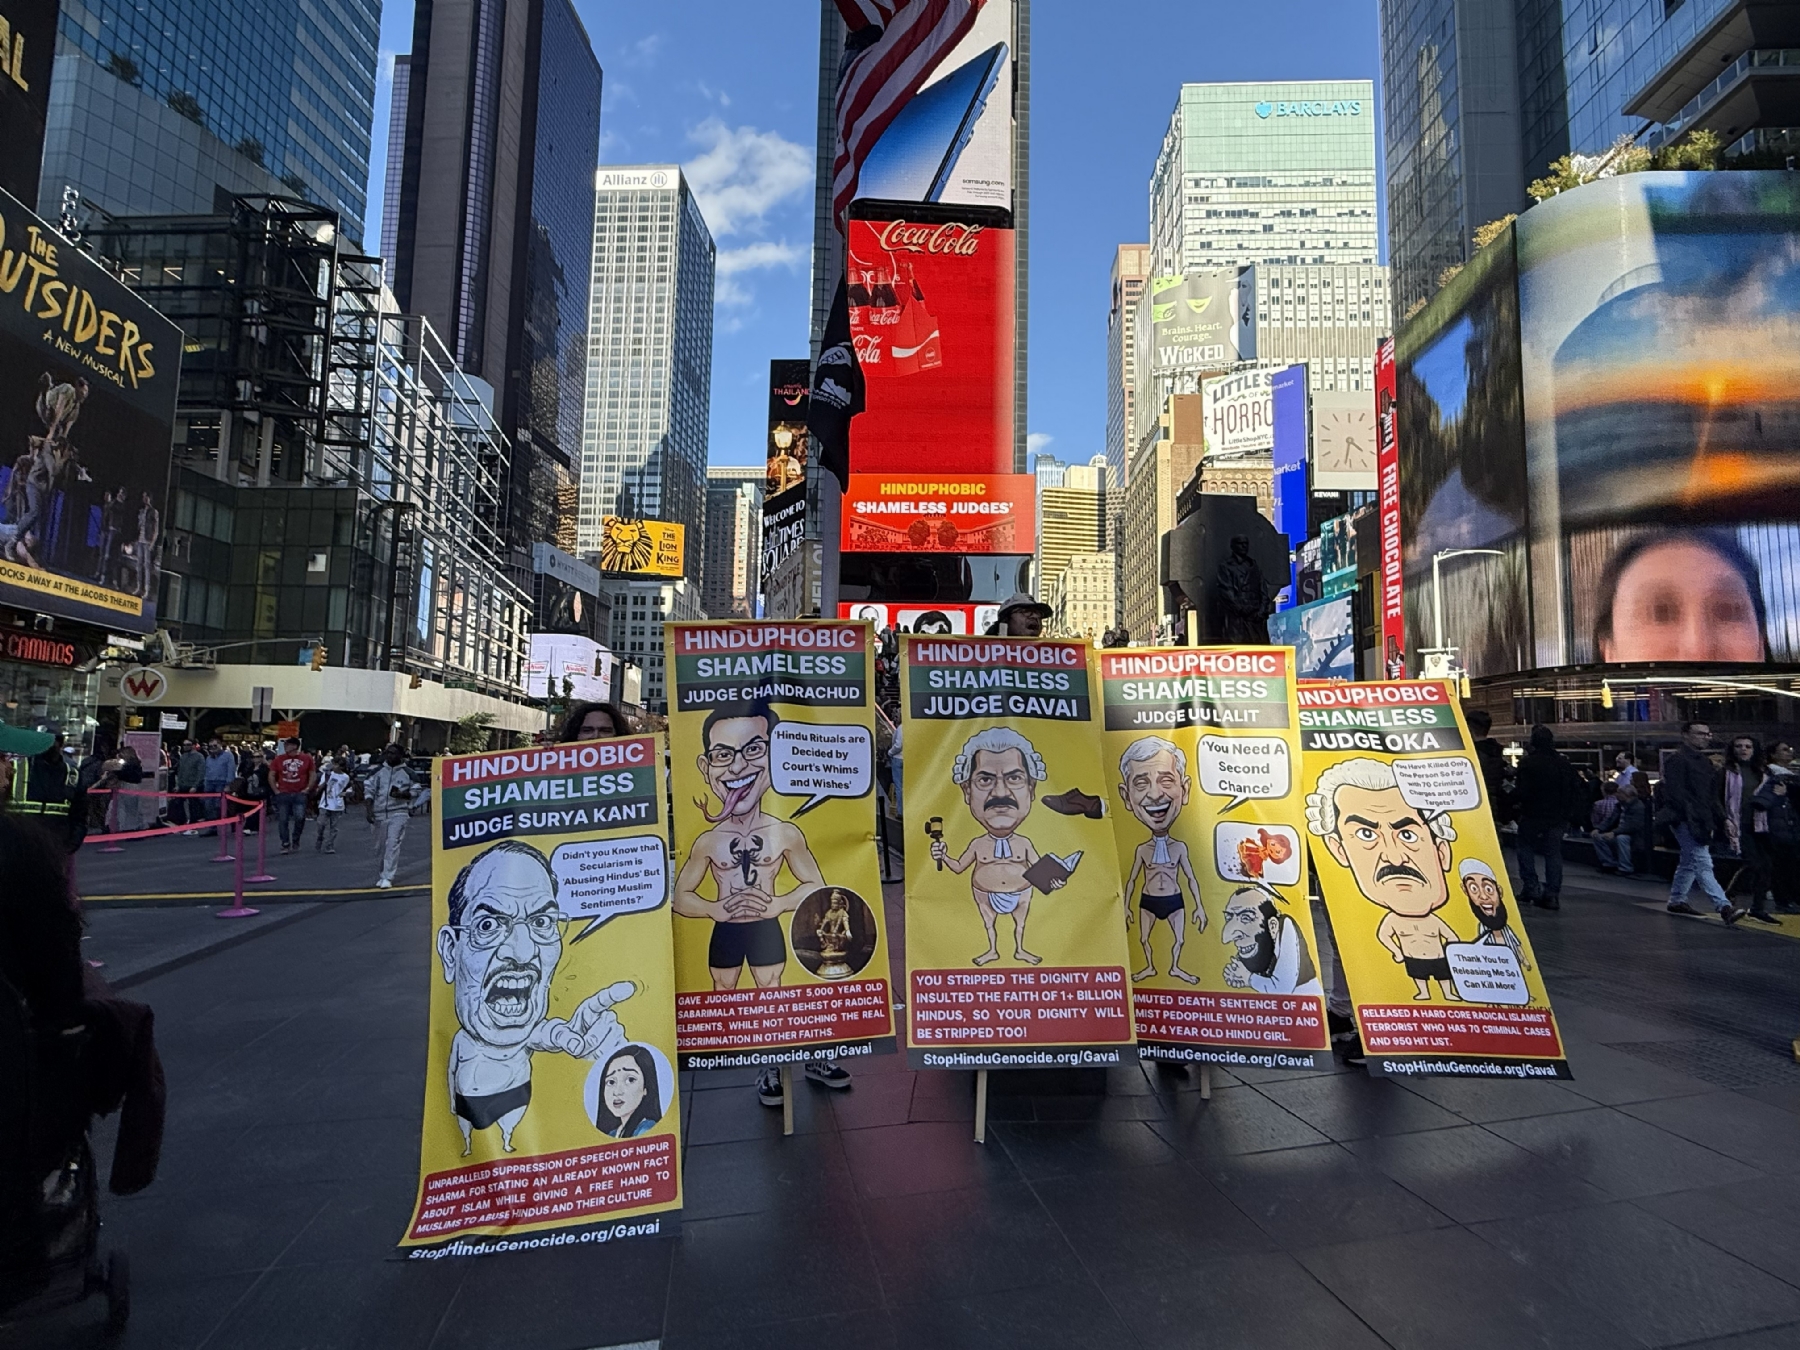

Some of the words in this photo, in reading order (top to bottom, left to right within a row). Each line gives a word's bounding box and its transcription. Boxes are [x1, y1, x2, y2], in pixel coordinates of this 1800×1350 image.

[1276, 101, 1361, 117] BARCLAYS
[602, 174, 647, 185] Allianz
[962, 178, 1005, 187] samsung.com
[27, 225, 59, 267] THE
[879, 219, 985, 255] Coca-Cola
[0, 211, 155, 390] UTSIDERS
[1162, 326, 1193, 336] Brains.
[1194, 322, 1222, 332] Heart.
[1172, 333, 1212, 343] Courage.
[42, 329, 54, 343] A
[55, 336, 82, 358] NEW
[83, 355, 125, 389] MUSICAL
[1213, 373, 1260, 405] LITTLE
[1213, 399, 1273, 446] HORRO
[880, 483, 986, 495] HINDUPHOBIC
[1383, 462, 1398, 509] FREE
[763, 504, 796, 527] WELCOME
[796, 499, 806, 512] TO
[662, 532, 675, 540] THE
[779, 518, 805, 544] TIMES
[659, 541, 677, 551] LION
[656, 552, 679, 565] KING
[1383, 512, 1401, 620] CHOCOLATE
[27, 574, 52, 588] AWAY
[53, 581, 62, 590] AT
[64, 584, 79, 595] THE
[80, 588, 108, 602] JACOBS
[110, 595, 139, 611] THEATRE
[1302, 578, 1322, 604] Si
[684, 627, 856, 650] HINDUPHOBIC
[917, 643, 1077, 665] HINDUPHOBIC
[697, 653, 846, 677] SHAMELESS
[1110, 655, 1276, 675] HINDUPHOBIC
[125, 675, 160, 698] W
[929, 669, 1070, 690] SHAMELESS
[684, 688, 738, 704] JUDGE
[741, 683, 860, 700] CHANDRACHUD
[1122, 680, 1268, 700] SHAMELESS
[924, 695, 1002, 715] JUDGE
[1009, 695, 1078, 717] GAVAI
[1133, 709, 1186, 724] JUDGE
[1188, 708, 1211, 721] UU
[1213, 709, 1260, 722] LALIT
[1299, 708, 1437, 727] SHAMELESS
[774, 730, 808, 741] 'Hindu
[810, 733, 845, 744] Rituals
[848, 735, 866, 744] are
[1309, 732, 1383, 750] JUDGE
[1385, 732, 1440, 751] OKA
[791, 746, 833, 759] Decided
[835, 750, 849, 761] by
[1202, 741, 1229, 754] 'You
[1232, 743, 1270, 755] Need
[1273, 744, 1285, 755] A
[453, 743, 645, 782] HINDUPHOBIC
[782, 762, 821, 773] Court's
[823, 764, 859, 774] Whims
[1218, 761, 1270, 774] Second
[464, 772, 634, 810] SHAMELESS
[790, 777, 810, 787] and
[812, 779, 852, 790] Wishes'
[1218, 779, 1273, 794] Chance'
[449, 814, 514, 841] JUDGE
[517, 810, 589, 829] SURYA
[593, 802, 650, 824] KANT
[562, 850, 590, 860] Didn't
[592, 849, 610, 859] you
[612, 847, 638, 856] Know
[640, 843, 660, 852] that
[580, 860, 633, 871] Secularism
[634, 857, 643, 866] is
[562, 874, 605, 886] 'Abusing
[606, 870, 642, 881] Hindus'
[644, 868, 660, 877] But
[570, 886, 616, 898] Honoring
[617, 882, 653, 893] Muslim
[916, 975, 942, 986] YOU
[947, 974, 1005, 985] STRIPPED
[1010, 974, 1035, 984] THE
[1040, 972, 1089, 984] DIGNITY
[1095, 972, 1121, 983] AND
[678, 996, 701, 1006] GAVE
[704, 993, 755, 1004] JUDGMENT
[759, 989, 802, 1000] AGAINST
[806, 986, 833, 998] 5,000
[838, 984, 861, 994] YEAR
[865, 983, 883, 992] OLD
[916, 992, 974, 1004] INSULTED
[977, 992, 1001, 1002] THE
[1003, 991, 1039, 1002] FAITH
[1041, 991, 1058, 1001] OF
[1060, 990, 1074, 1001] 1+
[1076, 989, 1123, 1000] BILLION
[677, 1006, 735, 1019] SABARIMALA
[738, 1003, 775, 1016] TEMPLE
[777, 1003, 790, 1013] AT
[792, 999, 828, 1012] BEHEST
[831, 999, 843, 1008] OF
[845, 995, 884, 1007] RADICAL
[916, 1010, 966, 1022] HINDUS,
[972, 1009, 990, 1020] SO
[997, 1009, 1031, 1020] YOUR
[1038, 1008, 1088, 1019] DIGNITY
[1095, 1007, 1124, 1018] WILL
[917, 1028, 932, 1039] BE
[935, 1027, 994, 1039] STRIPPED
[996, 1026, 1027, 1038] TOO!
[1370, 1036, 1391, 1046] AND
[1392, 1037, 1413, 1046] 950
[1414, 1037, 1428, 1046] HIT
[1430, 1037, 1453, 1046] LIST.
[688, 1042, 872, 1069] StopHinduGenocide.org/Gavai
[923, 1050, 1119, 1067] StopHinduGenocide.org/Gavai
[1137, 1046, 1314, 1067] pHinduGenocide.org/Gavai
[1383, 1060, 1557, 1077] StopHinduGenocide.org/Gavai
[421, 1205, 455, 1220] ABOUT
[461, 1199, 491, 1212] ISLAM
[496, 1193, 526, 1207] WHILE
[532, 1188, 568, 1201] GIVING
[574, 1186, 583, 1195] A
[589, 1180, 614, 1192] FREE
[620, 1174, 649, 1188] HAND
[656, 1171, 670, 1181] TO
[409, 1218, 660, 1260] StopHinduGenocide.org/Gavai
